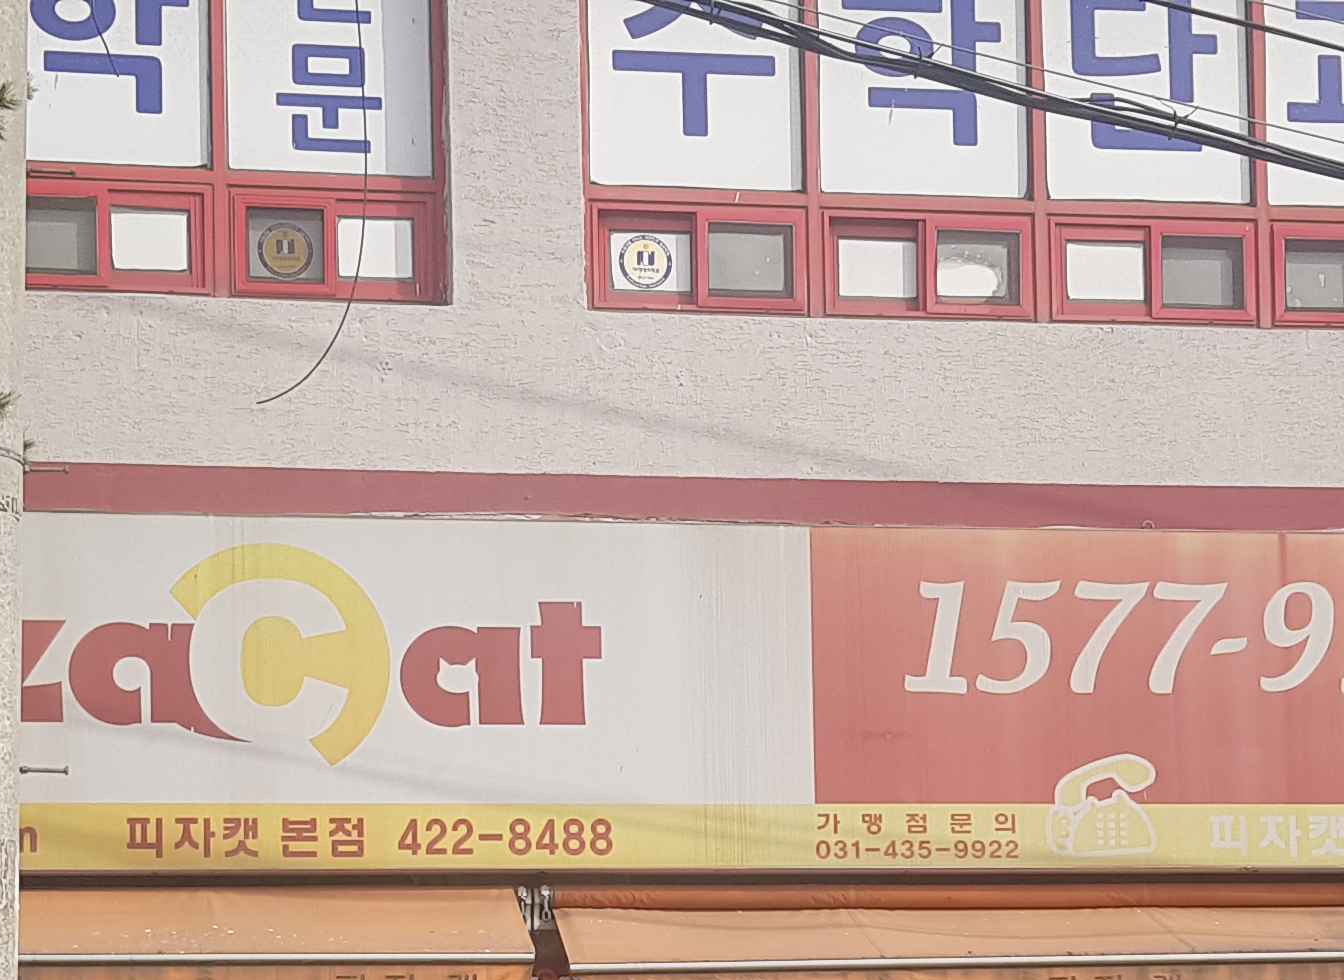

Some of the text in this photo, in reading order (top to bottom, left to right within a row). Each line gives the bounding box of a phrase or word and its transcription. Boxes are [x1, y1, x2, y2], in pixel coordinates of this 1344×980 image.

[125, 814, 614, 860] 피자캣 본점 422-8488
[815, 839, 1021, 861] 031-435-9922
